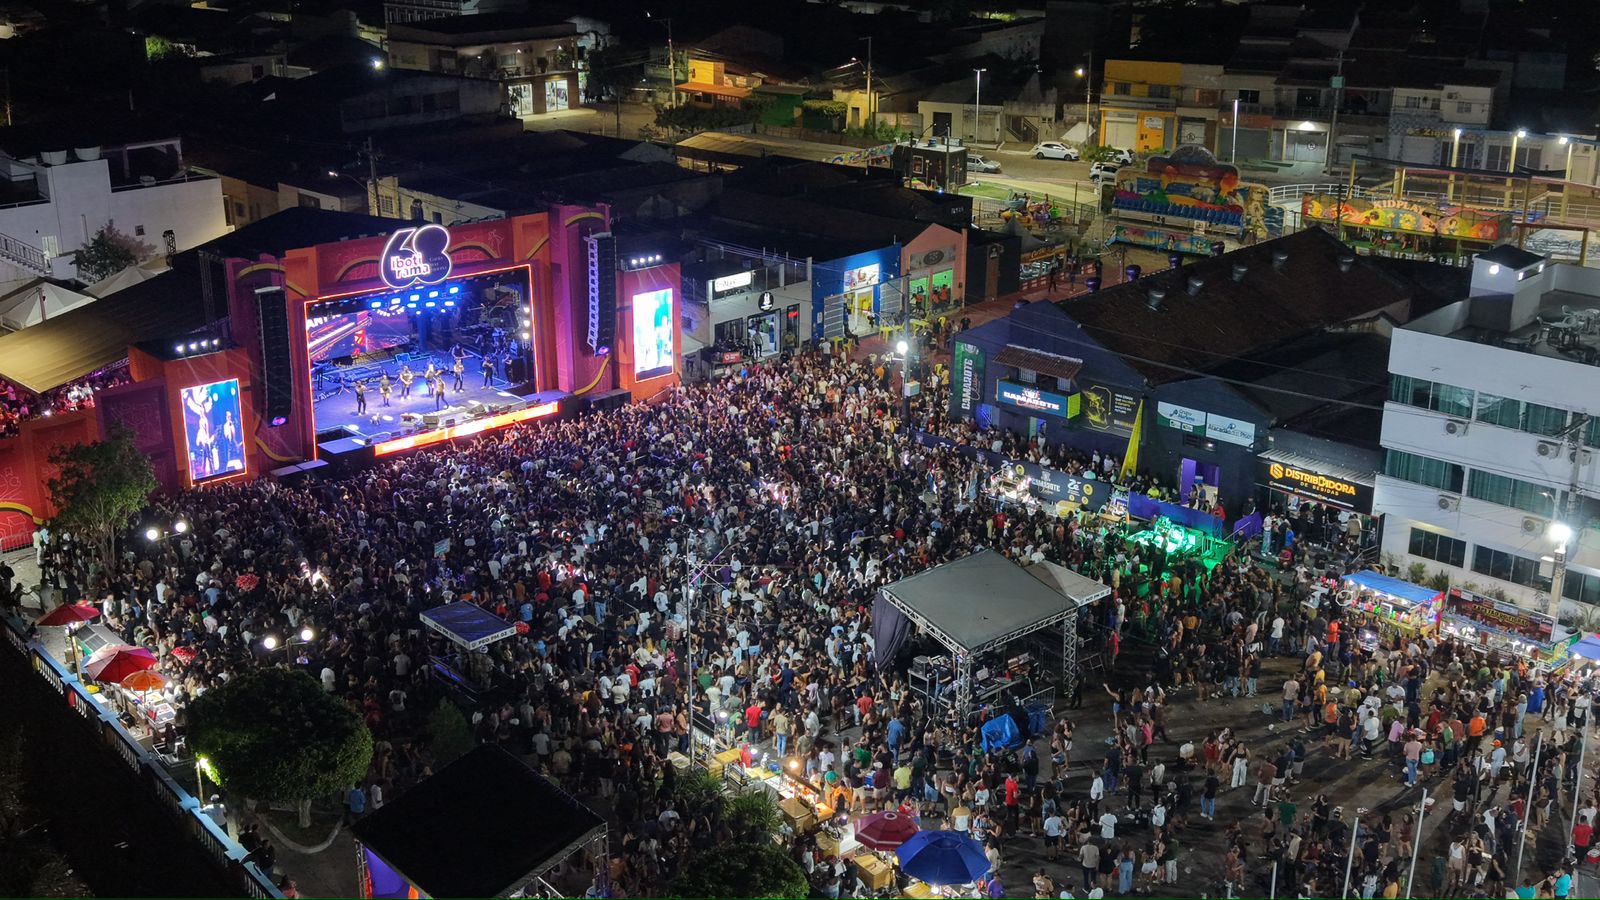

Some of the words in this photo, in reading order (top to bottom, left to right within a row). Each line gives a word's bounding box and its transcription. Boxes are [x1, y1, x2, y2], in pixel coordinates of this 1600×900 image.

[397, 264, 429, 277] rama
[961, 358, 973, 410] CAMAROTE
[1312, 485, 1340, 496] BEBIDAS
